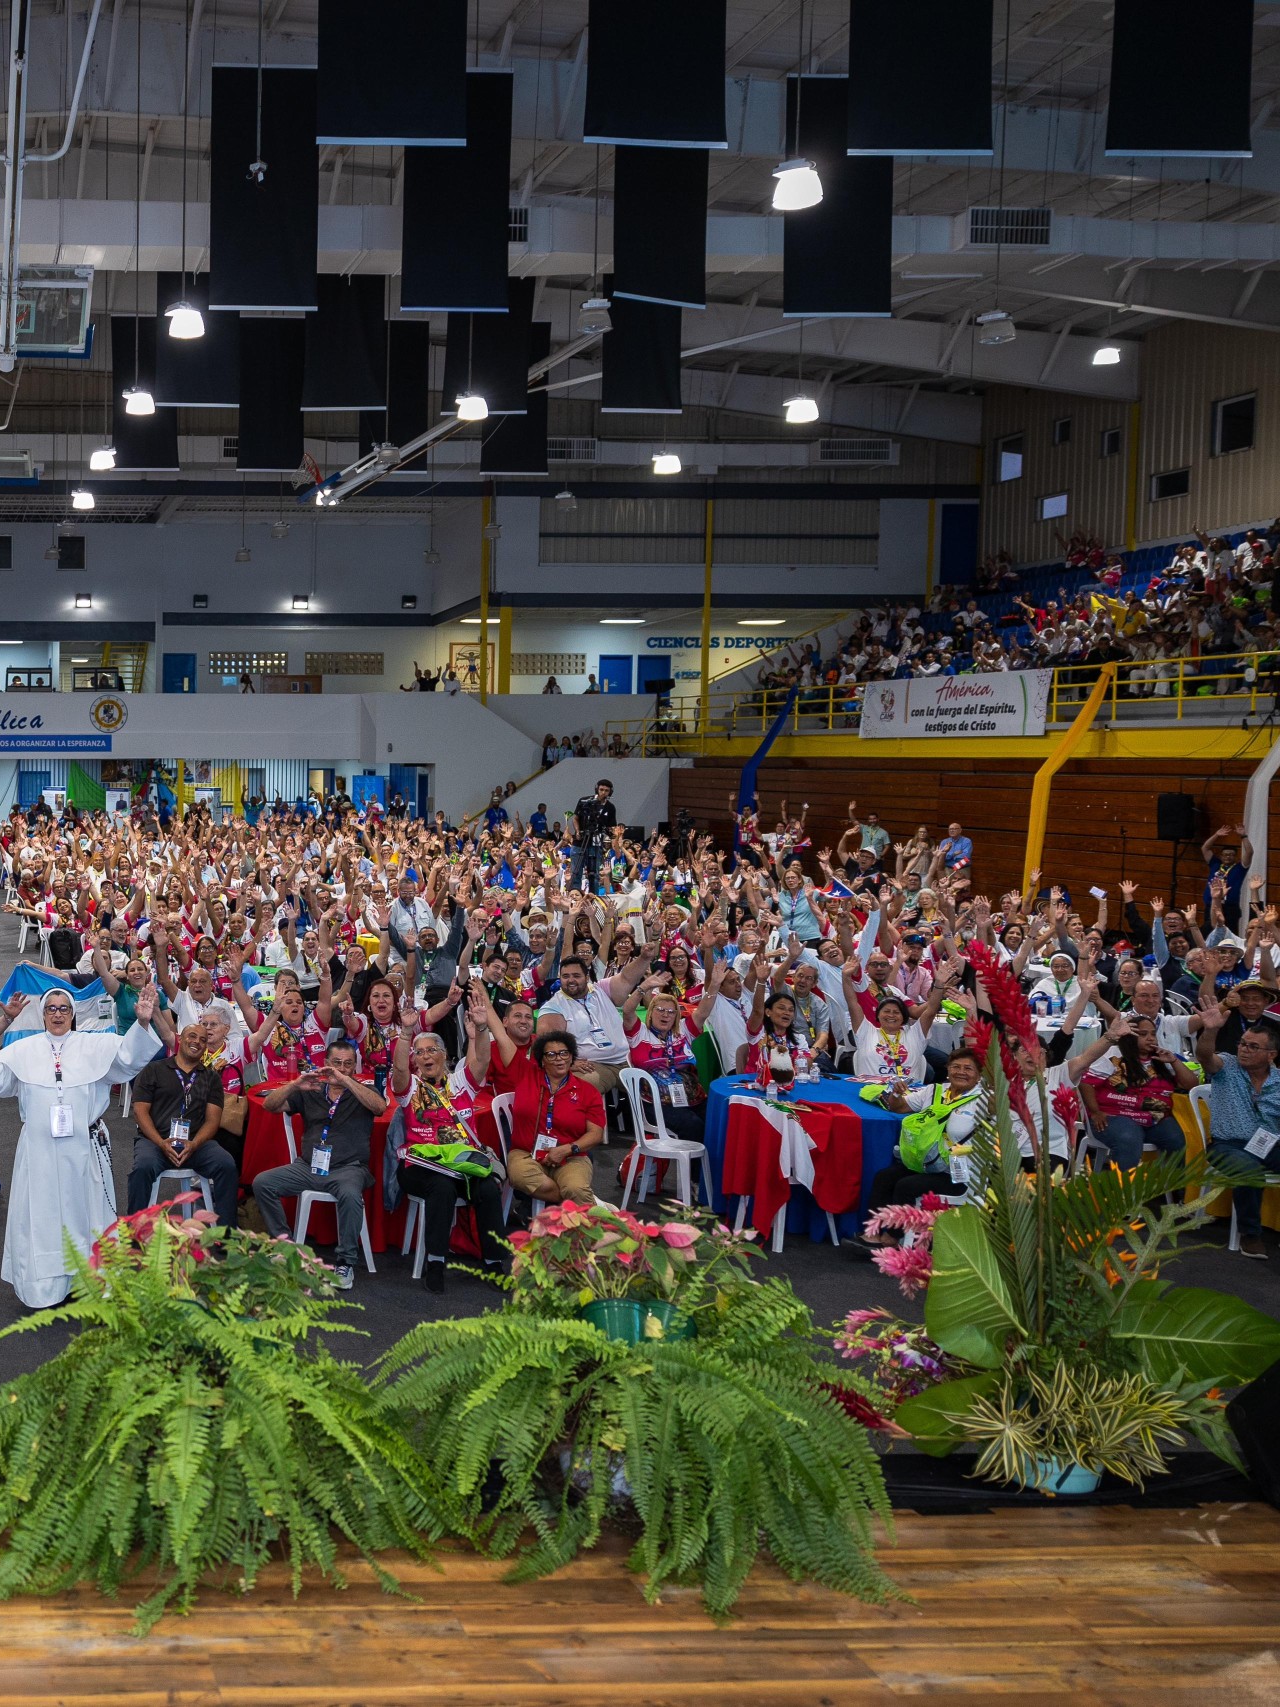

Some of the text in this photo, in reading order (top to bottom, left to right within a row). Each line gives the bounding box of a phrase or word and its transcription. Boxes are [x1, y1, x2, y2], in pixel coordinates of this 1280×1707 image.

[646, 636, 720, 649] CIENCIS
[936, 676, 994, 704] América,
[911, 702, 1017, 718] con la fuerza del Espíritu,
[924, 720, 996, 734] testigos de Cristo
